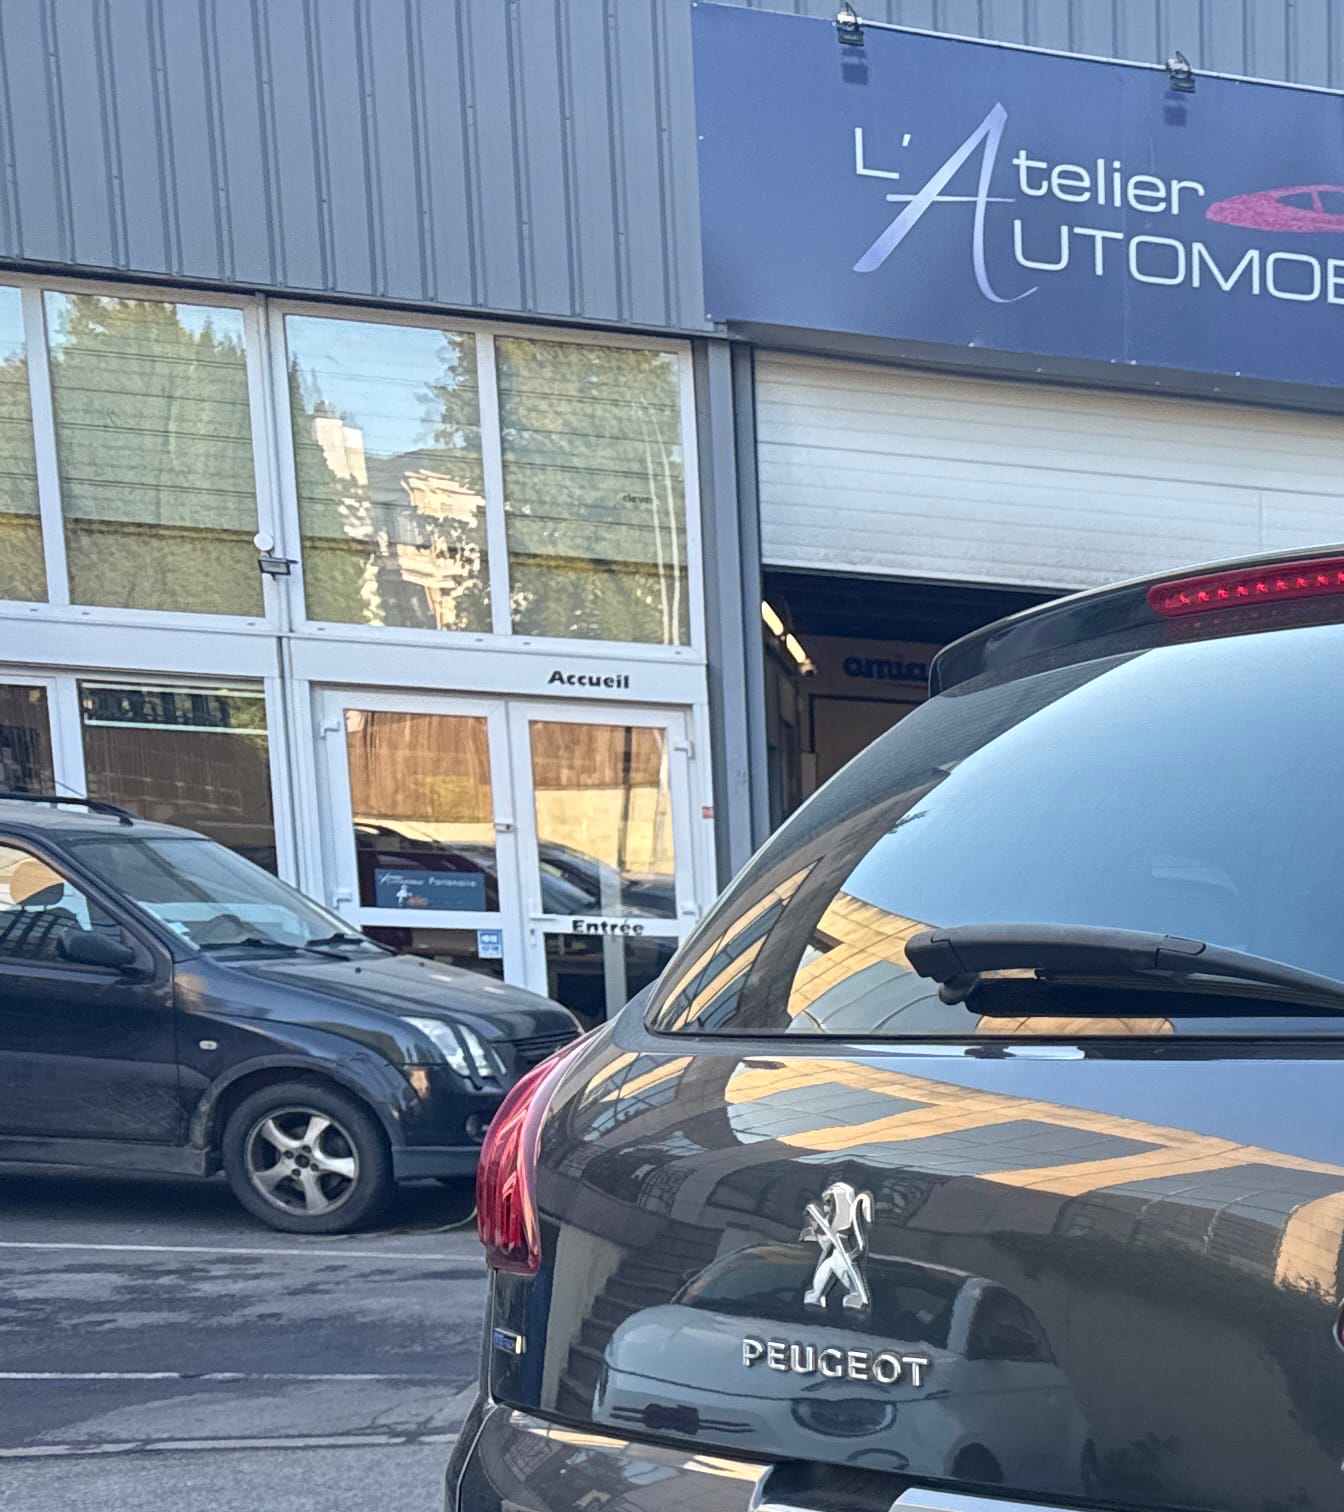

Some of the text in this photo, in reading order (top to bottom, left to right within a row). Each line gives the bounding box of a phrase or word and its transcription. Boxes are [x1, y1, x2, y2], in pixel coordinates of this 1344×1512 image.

[548, 670, 630, 689] Accueil
[572, 918, 644, 936] Entrée
[742, 1337, 930, 1387] PEUGEOT
